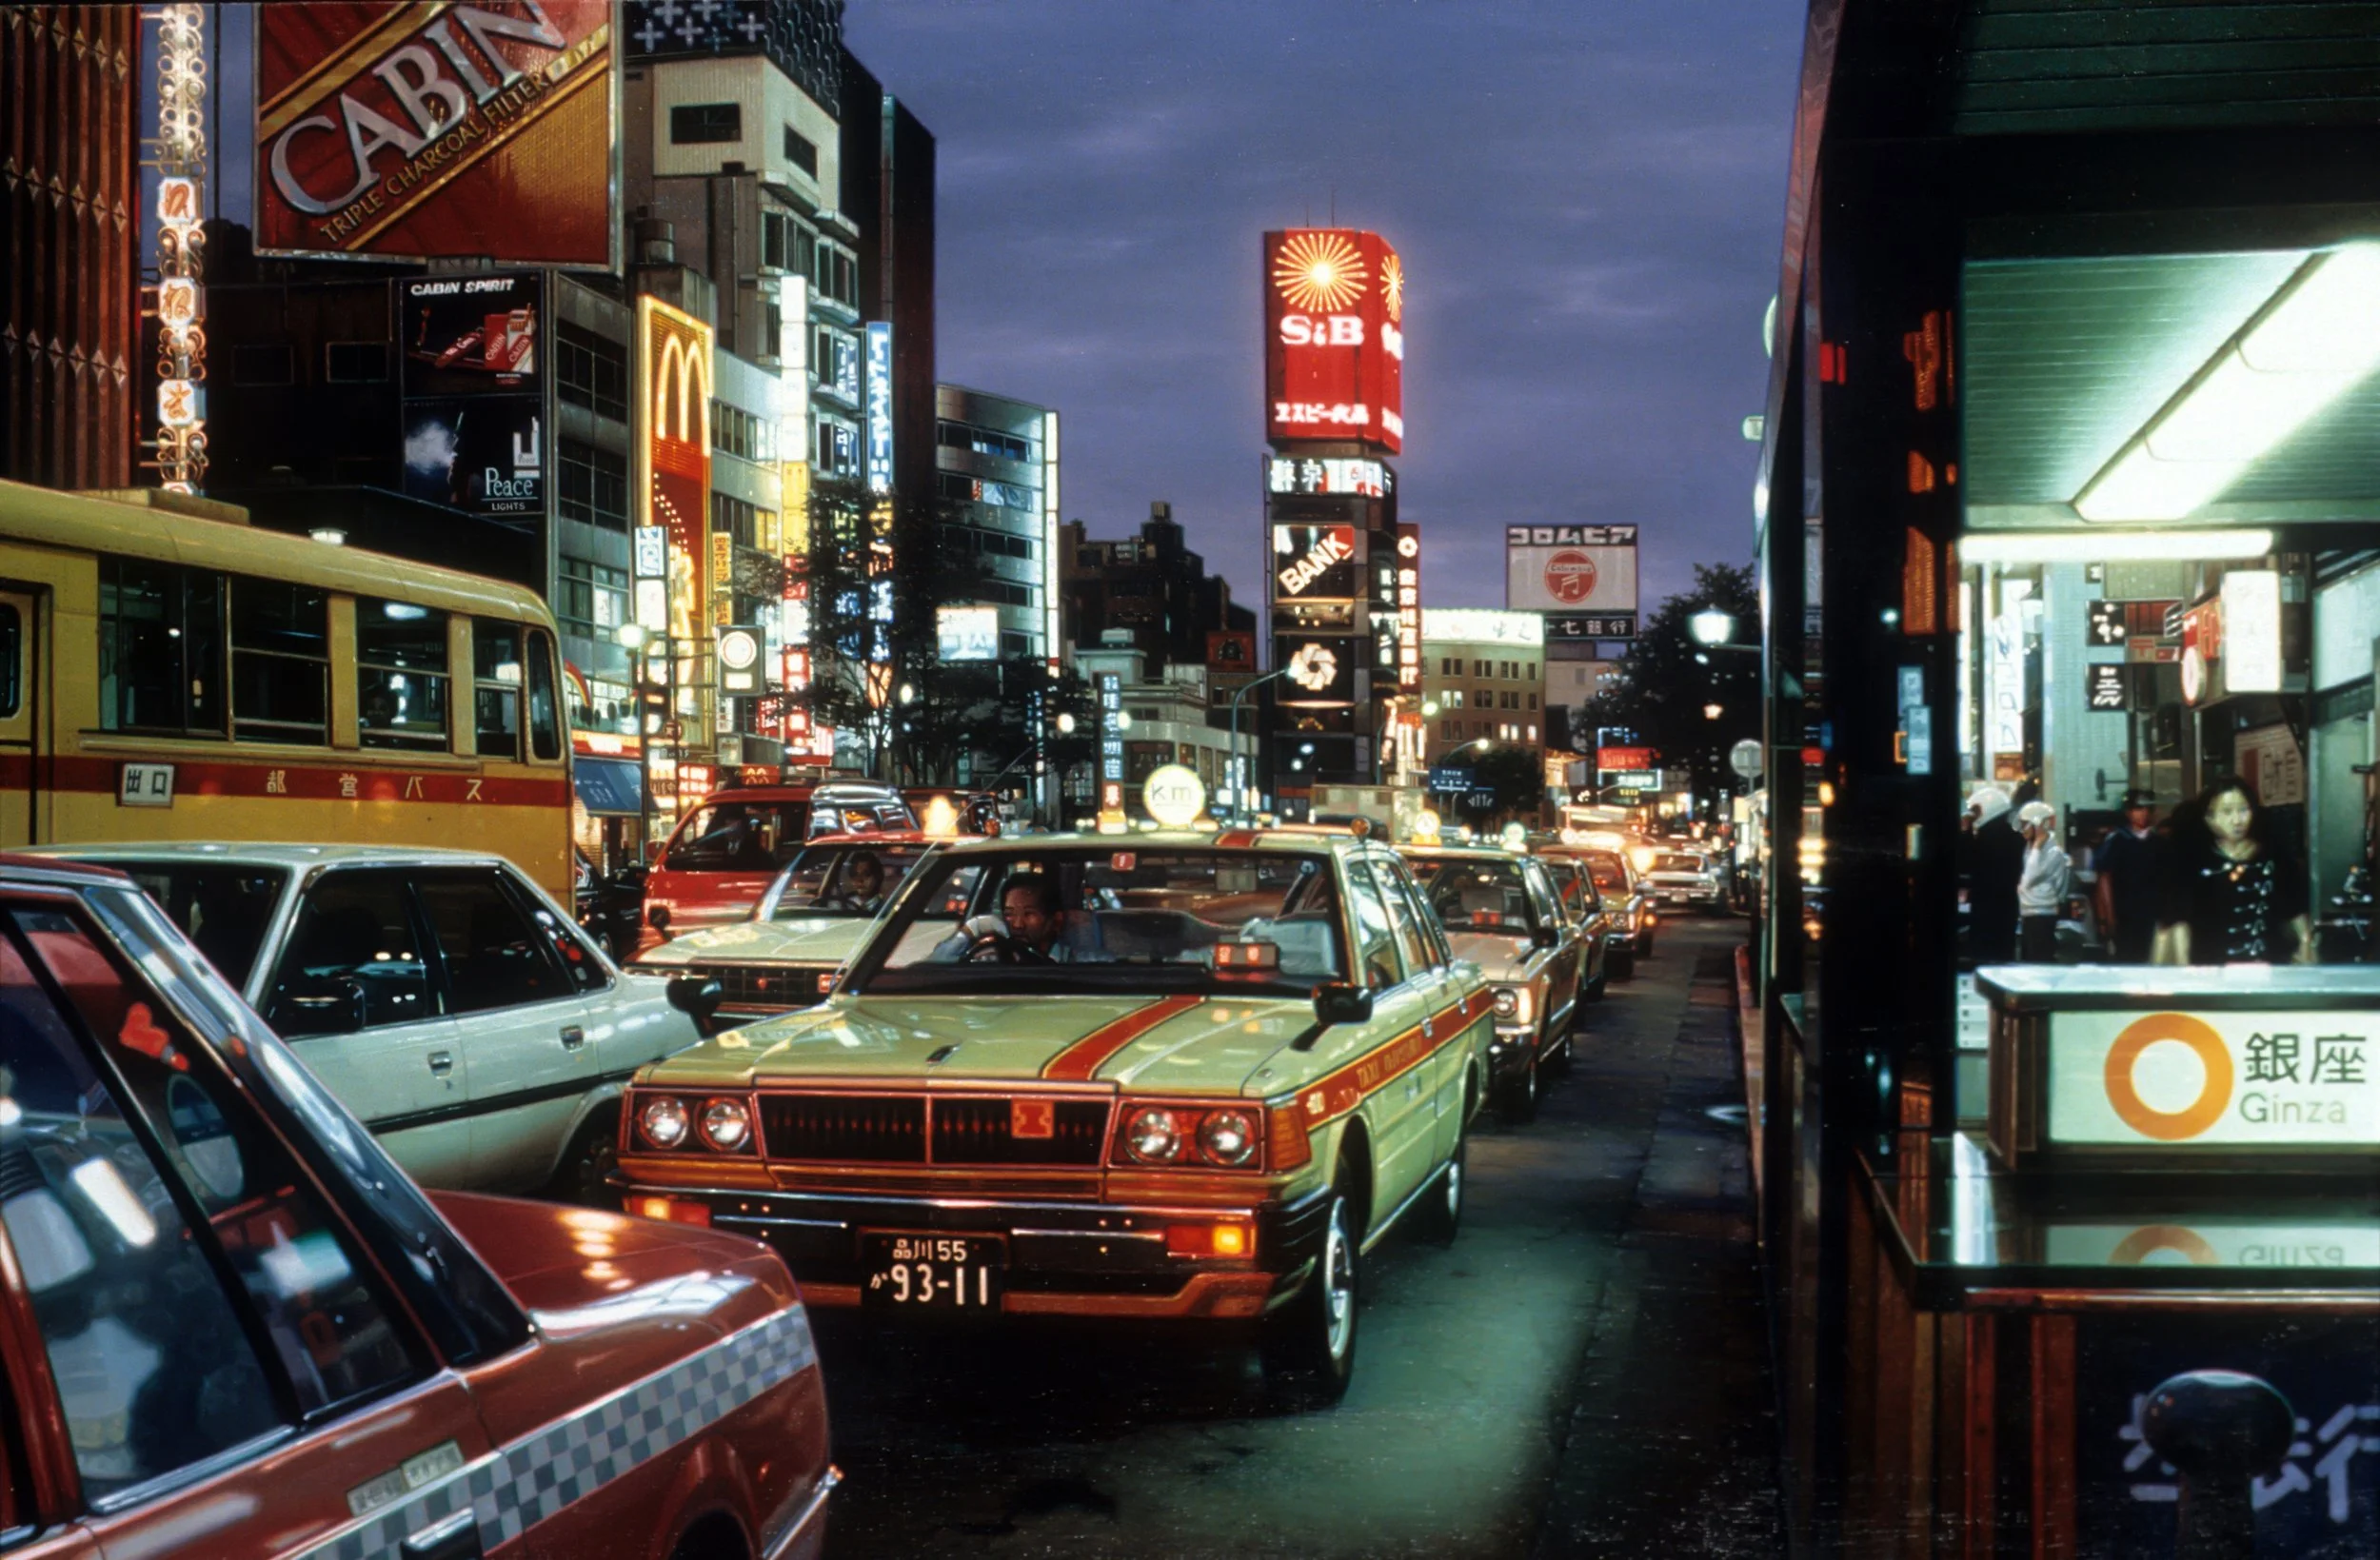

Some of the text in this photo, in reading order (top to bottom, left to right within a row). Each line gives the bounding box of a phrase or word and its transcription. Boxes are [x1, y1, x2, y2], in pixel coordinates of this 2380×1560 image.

[270, 2, 566, 215] CABIN
[321, 71, 549, 243] TRIPLE CHARCOAL FILTER
[410, 279, 514, 296] CABIN SPIRIT
[486, 467, 533, 496] Peace
[491, 503, 526, 511] LIGHTS
[1508, 526, 1636, 544] コロムビア
[1279, 532, 1351, 595] BANK
[125, 768, 167, 796] 出口
[267, 769, 483, 800] 都営バス
[2244, 1032, 2368, 1084] 銀座
[2239, 1092, 2348, 1124] Ginza
[893, 1238, 967, 1261] 品川 55
[891, 1263, 987, 1306] 93-11
